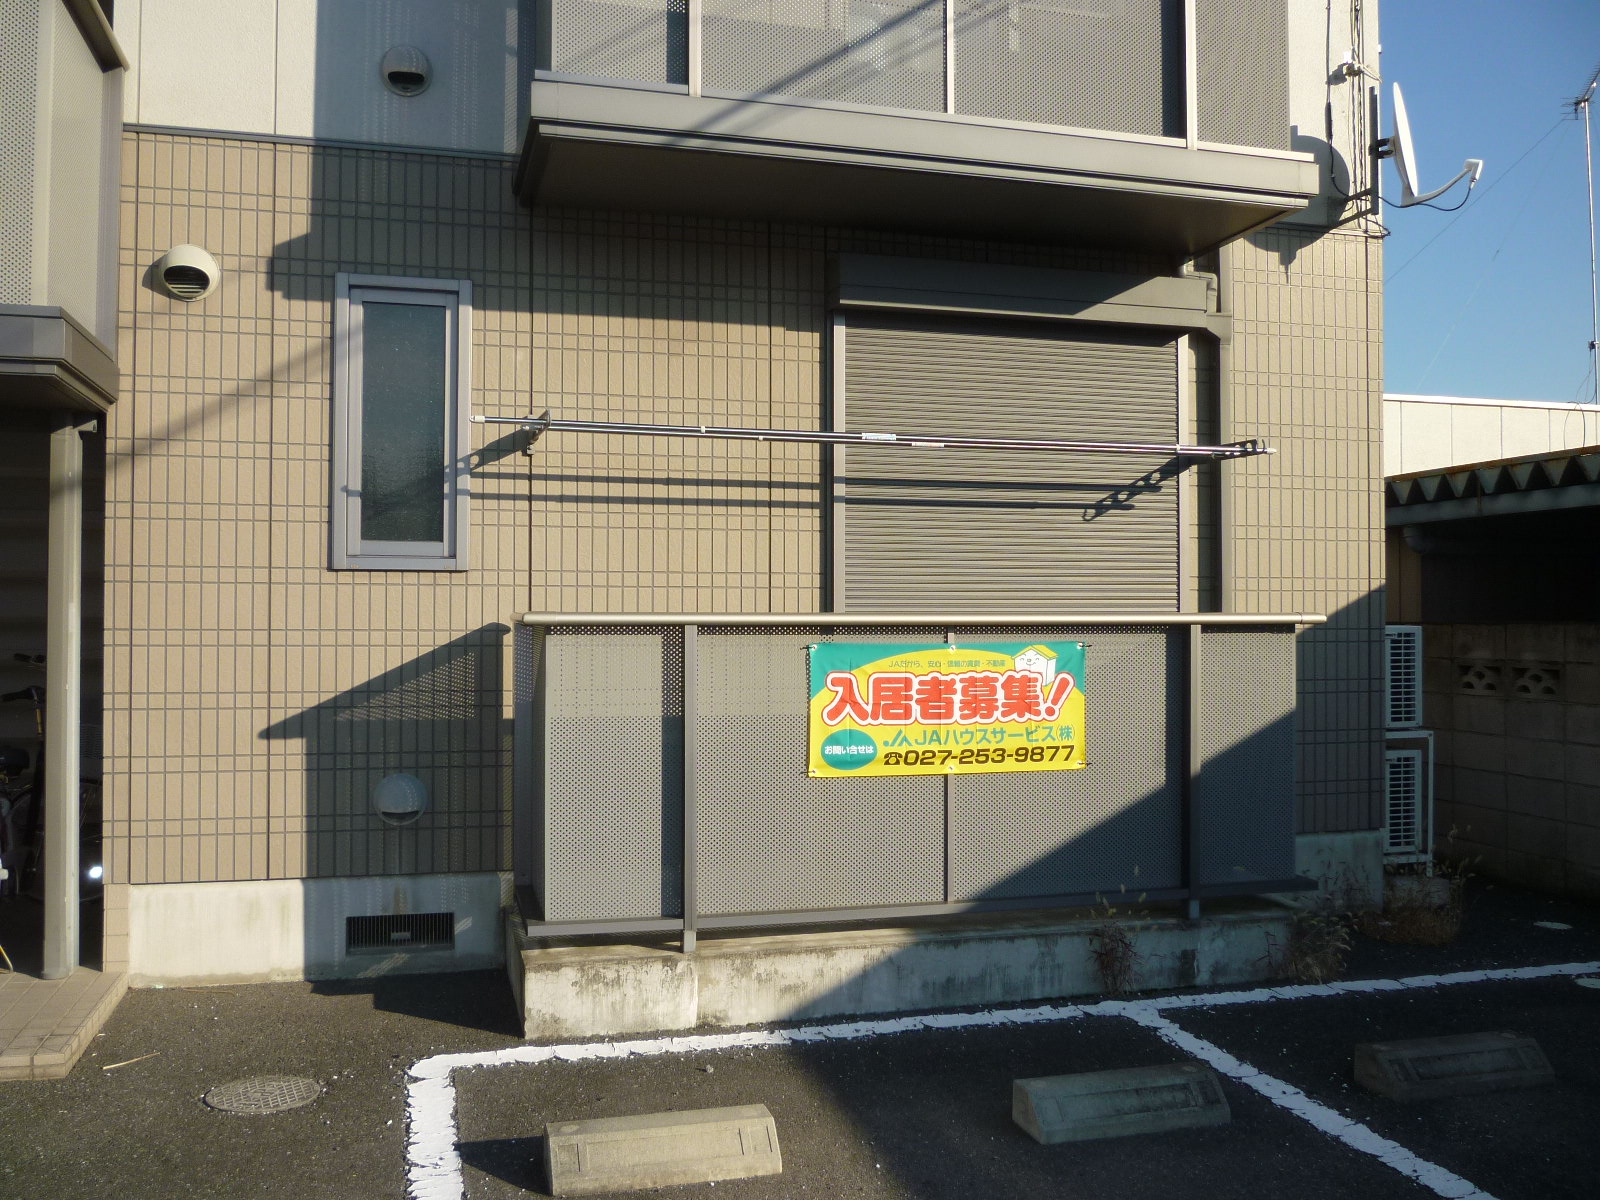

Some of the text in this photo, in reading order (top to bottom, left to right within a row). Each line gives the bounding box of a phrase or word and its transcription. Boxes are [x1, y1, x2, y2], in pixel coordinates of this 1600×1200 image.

[822, 671, 1075, 727] 入居者募集!
[824, 744, 874, 755] お問い合せは
[904, 745, 1075, 766] 027-253-9877
